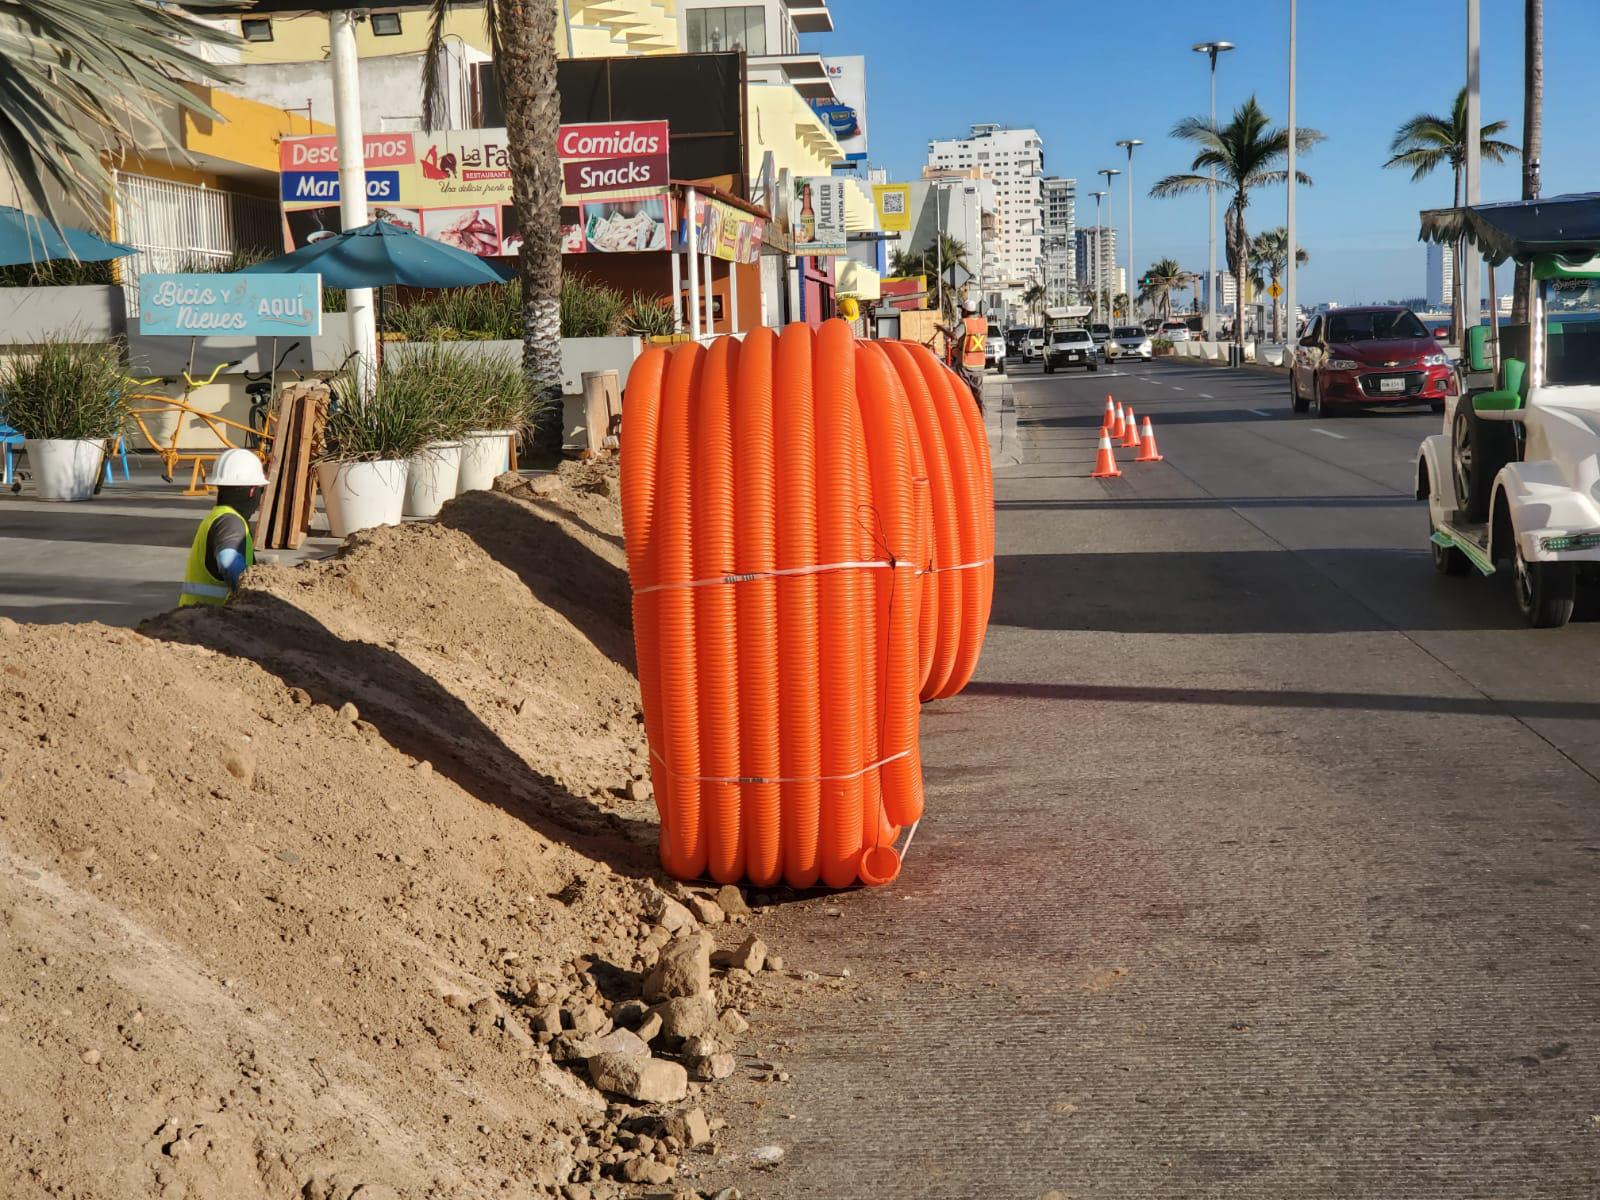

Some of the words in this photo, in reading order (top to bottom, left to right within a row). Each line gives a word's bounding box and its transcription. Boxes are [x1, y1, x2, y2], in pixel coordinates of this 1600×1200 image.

[292, 139, 407, 165] Desanos
[461, 145, 481, 162] La
[563, 130, 660, 154] Comidas
[296, 175, 391, 197] Maros
[580, 161, 650, 188] Snacks
[818, 184, 835, 230] PACIFICO
[839, 223, 844, 233] DE
[153, 280, 217, 307] Bicis
[175, 306, 248, 330] Nieves
[257, 294, 303, 318] AQUÍ
